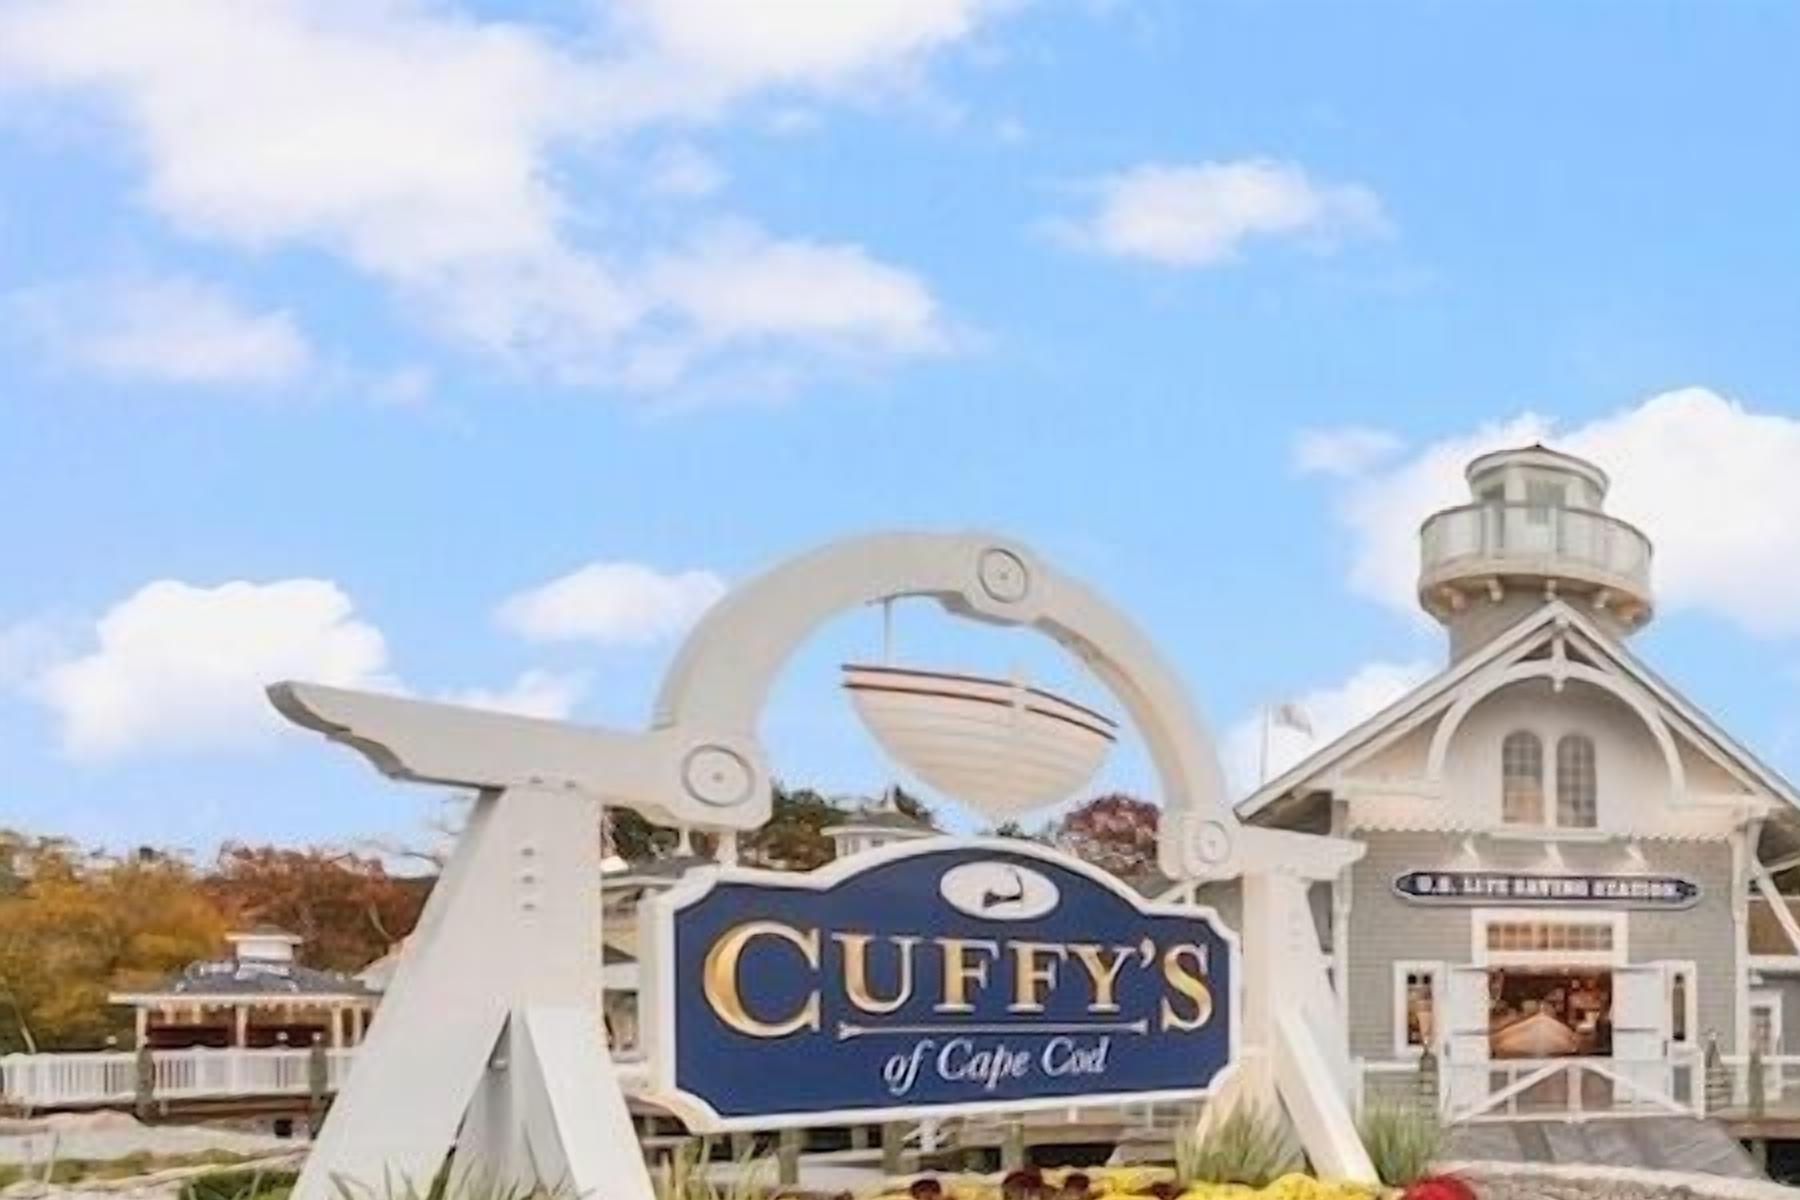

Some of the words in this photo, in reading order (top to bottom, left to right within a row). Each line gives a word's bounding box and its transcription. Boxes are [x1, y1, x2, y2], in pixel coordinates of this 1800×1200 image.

[703, 921, 1214, 1038] CUFFY'S
[884, 1038, 935, 1096] of
[937, 1037, 1031, 1092] Cape
[1041, 1035, 1110, 1077] Cod
